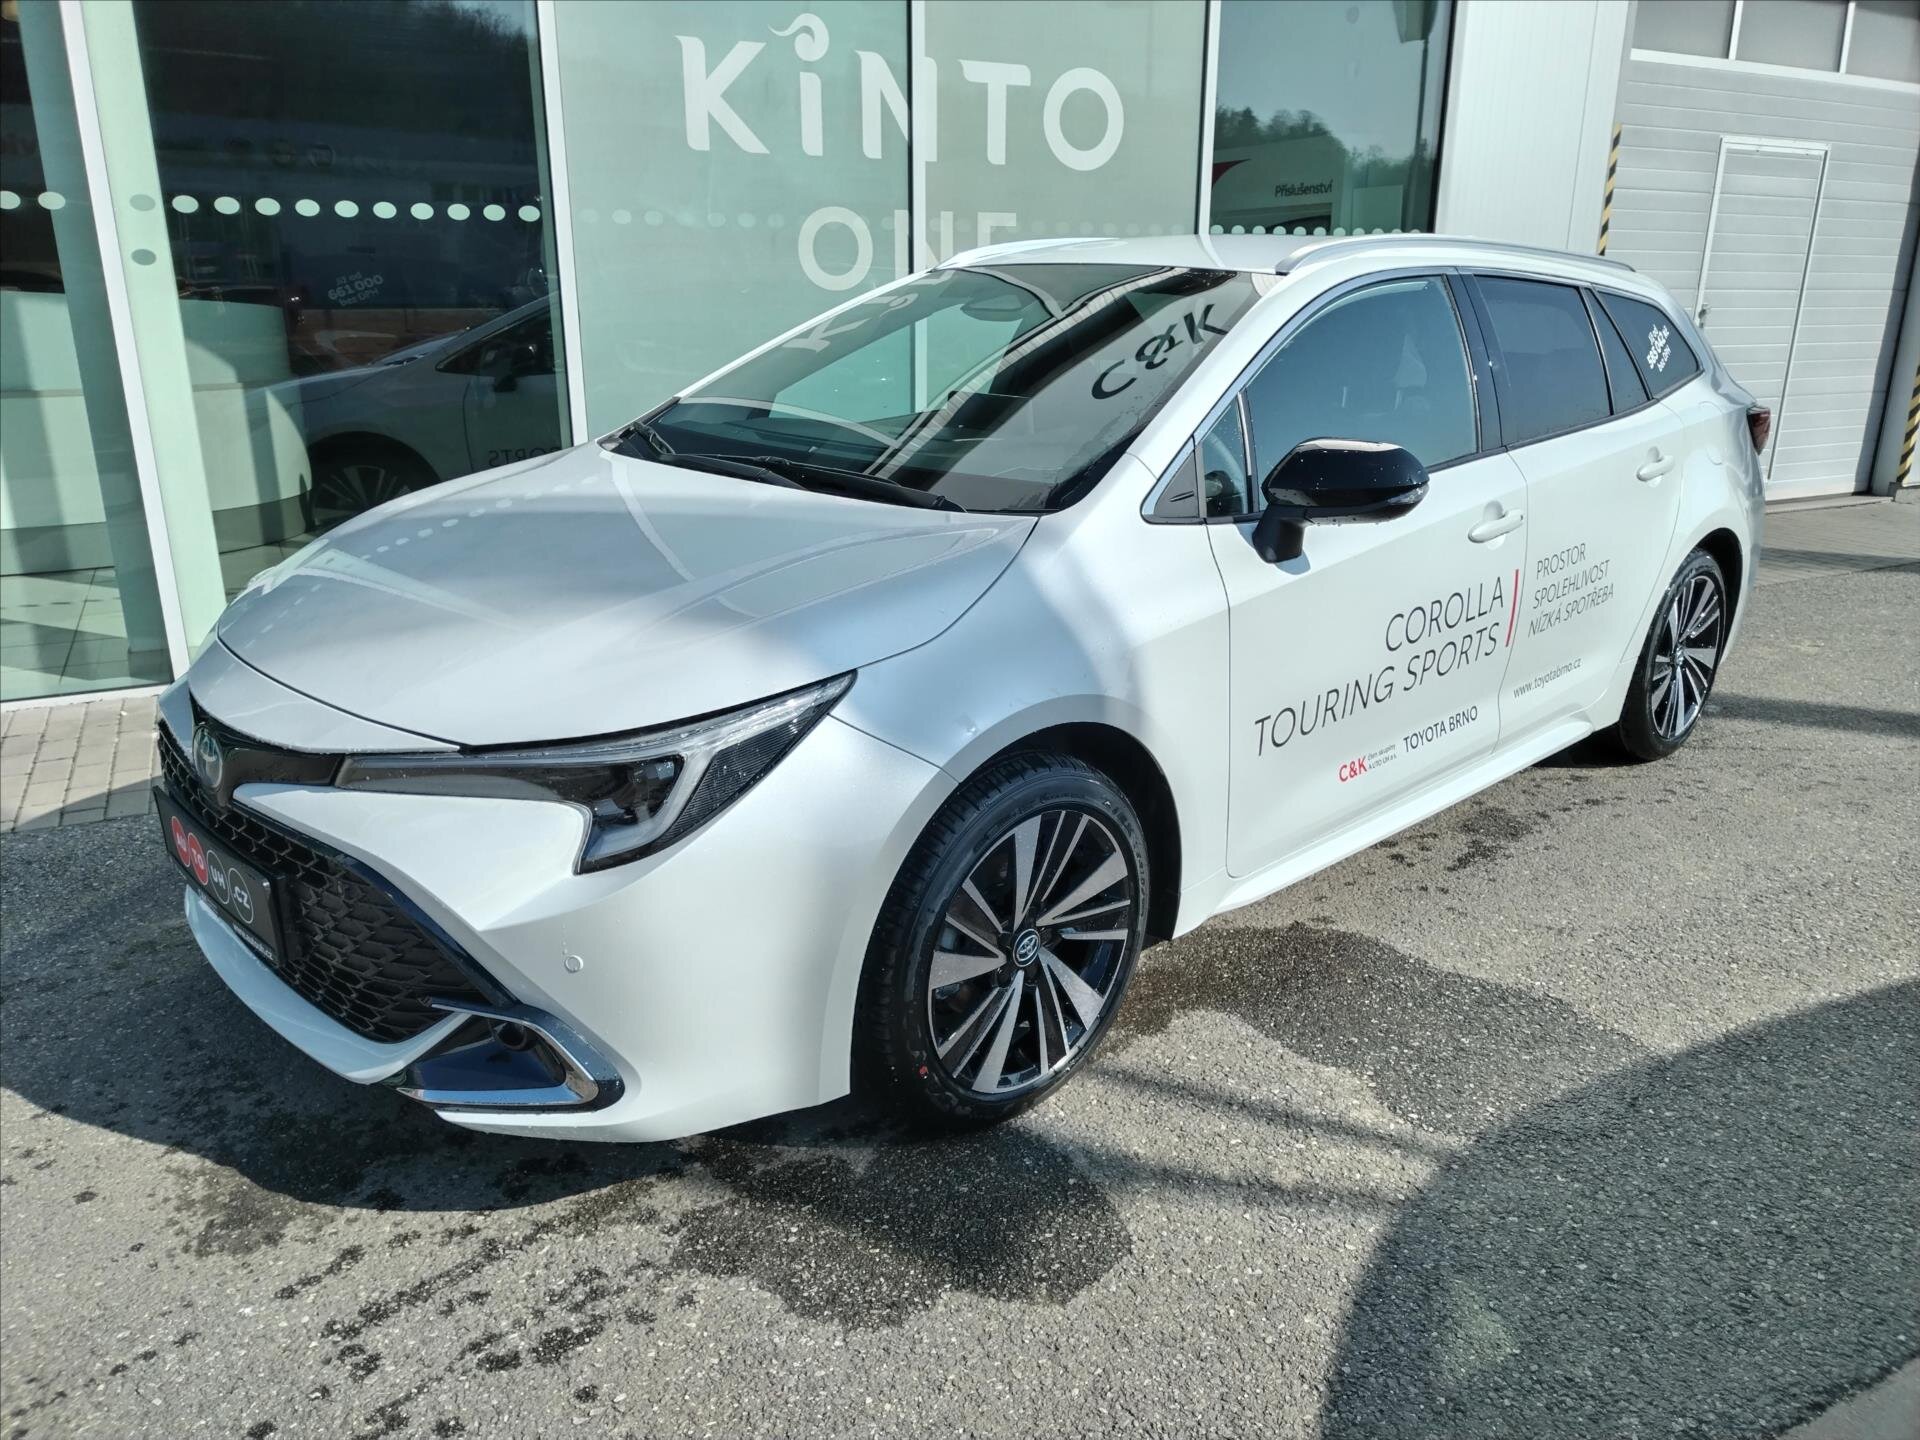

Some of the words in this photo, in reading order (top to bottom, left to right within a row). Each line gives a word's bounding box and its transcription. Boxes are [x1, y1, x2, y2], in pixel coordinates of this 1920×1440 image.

[354, 274, 384, 290] 000
[1536, 542, 1586, 580] PROSTOR
[1532, 559, 1610, 610] SPOLEHLIVOST
[1385, 577, 1504, 652] COROLLA
[1527, 602, 1561, 638] NÍZKÁ
[1563, 583, 1614, 622] SPOTŘEBA
[1254, 665, 1395, 757] TOURING
[1403, 622, 1500, 692] SPORTS
[1513, 658, 1582, 699] www.toyotabrno.cz
[1403, 720, 1447, 753] TOYOTA
[1448, 705, 1478, 732] BRNO
[1338, 756, 1368, 782] C&K
[210, 865, 226, 890] UH
